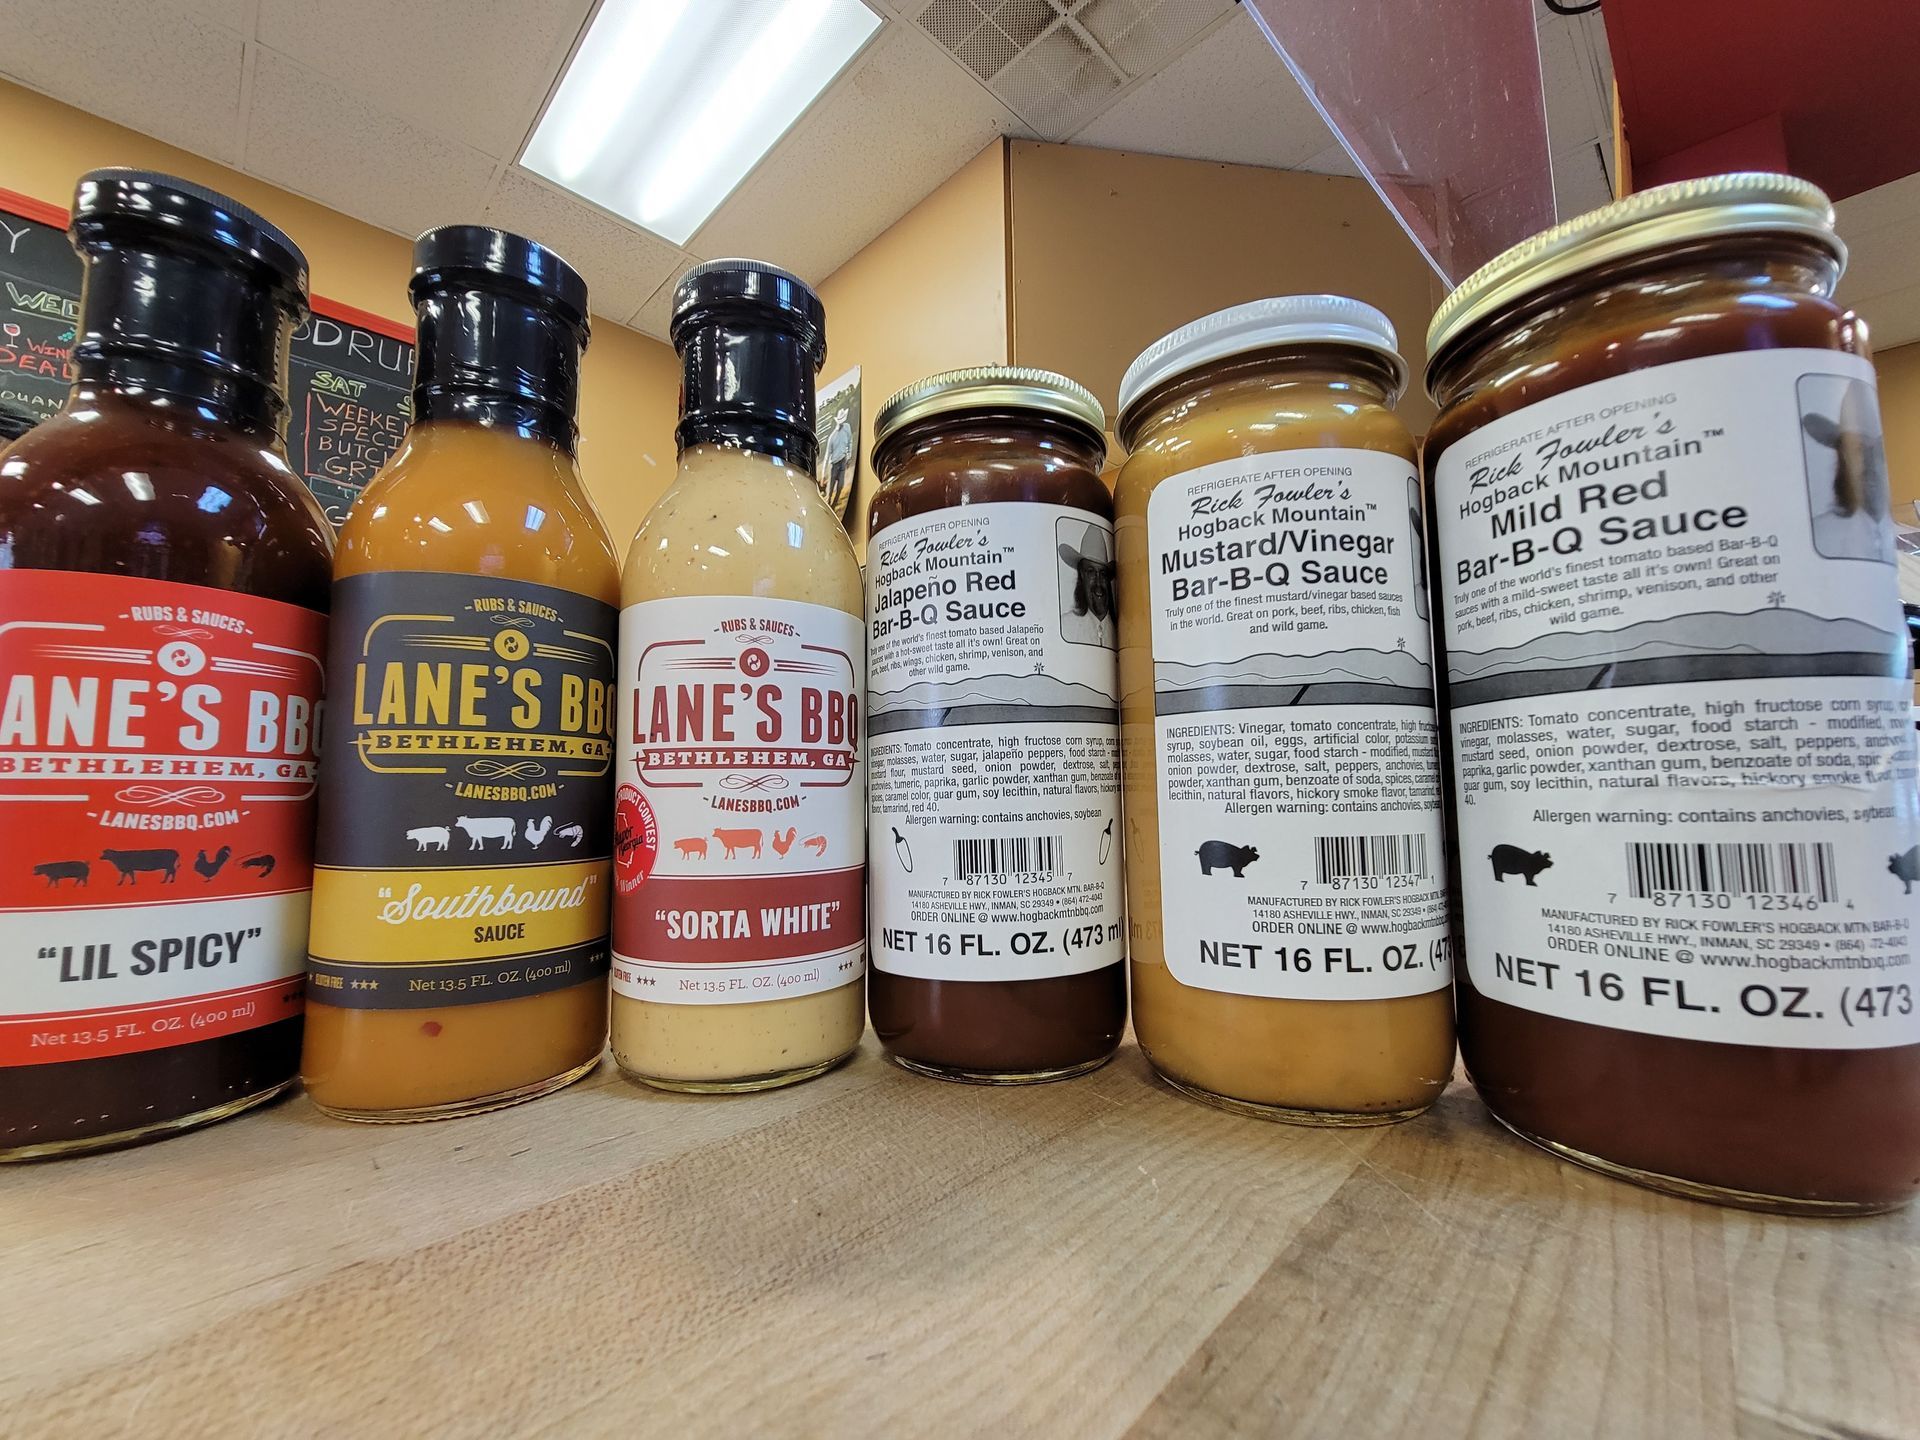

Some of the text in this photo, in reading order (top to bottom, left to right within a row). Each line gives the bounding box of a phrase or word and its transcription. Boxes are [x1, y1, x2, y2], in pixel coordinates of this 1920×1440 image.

[311, 371, 366, 397] SAT
[1465, 392, 1677, 469] REFRIGERATE AFTER OPENING
[1469, 412, 1676, 494] Rick Fowler's
[1188, 467, 1352, 496] REFRIGERATE AFTER OPENING
[1459, 472, 1549, 519] Hogback
[1190, 481, 1351, 520] Rick Fowler's
[1490, 469, 1668, 539] Mild Red
[879, 517, 990, 550] REFRIGERATE AFTER OPENING
[1178, 511, 1264, 541] Hogback
[880, 529, 989, 570] Rick Fowler's
[1162, 530, 1394, 575] Mustard/Vinegar
[1457, 505, 1748, 585] Bar-B-Q Sauce
[876, 562, 921, 589] Hogback
[1173, 560, 1388, 601] Bar-B-Q Sauce
[875, 570, 1016, 614] Jalapeño Red
[131, 606, 244, 633] RUBS & SAUCES
[474, 598, 558, 622] RUBS & SAUCES
[873, 601, 1026, 640] Bar-B-Q Sauce
[721, 618, 794, 636] RUBS & SAUCES
[1250, 620, 1328, 634] and wild game.
[354, 662, 542, 729] LANE'S
[0, 675, 222, 750] ANE'S
[633, 684, 858, 752] LANE'S BBQ
[1459, 716, 1523, 734] INGREDIENTS:
[1528, 712, 1578, 727] Tomato
[1588, 703, 1695, 722] concentrate,
[376, 735, 604, 756] BETHLEHEM, GA
[649, 752, 846, 767] BETHLEHEM, GA
[0, 758, 309, 779] BETHLEHEM, GA
[455, 782, 557, 801] LANESBBQ.COM
[711, 795, 799, 813] LANESBBQ.COM
[100, 810, 238, 831] LANESBBQ.COM
[639, 801, 655, 851] CONTEST
[905, 809, 1101, 826] Allergen warning: contains anchovies, soybean
[909, 887, 1066, 899] MANUFACTURED BY RICK FOWLER'S HOGBACK
[967, 874, 1007, 885] 87130
[1015, 872, 1052, 884] 12345
[1068, 873, 1072, 881] 7
[1301, 881, 1308, 890] 7
[1332, 877, 1378, 890] 87130
[1386, 875, 1420, 888] 12347
[911, 904, 1103, 923] ORDER ONLINE @ www.hogbackmtnbbq.com
[1608, 892, 1854, 910] 7 87130 12346 4
[474, 922, 526, 943] SAUCE
[655, 901, 840, 940] "SORTA WHITE"
[883, 916, 1124, 955] NET 16 FL. OZ. (473 ml)
[1253, 921, 1357, 935] ORDER ONLINE @
[38, 928, 261, 982] "LIL SPICY"
[1200, 940, 1262, 969] NET
[1275, 947, 1311, 972] 16
[1324, 948, 1372, 972] FL.
[1383, 944, 1423, 971] OZ.
[1548, 937, 1598, 954] ORDER
[1604, 944, 1670, 962] ONLINE
[1676, 950, 1694, 964] @
[409, 960, 571, 992] Net 13.5 FL. OZ. (400 ml)
[679, 969, 820, 991] Net 13.5 FL. OZ. (400 ml)
[1495, 953, 1913, 1027] NET 16 FL. OZ. (473
[31, 1002, 255, 1047] Net 13.5 FL. OZ. (400 ml)
